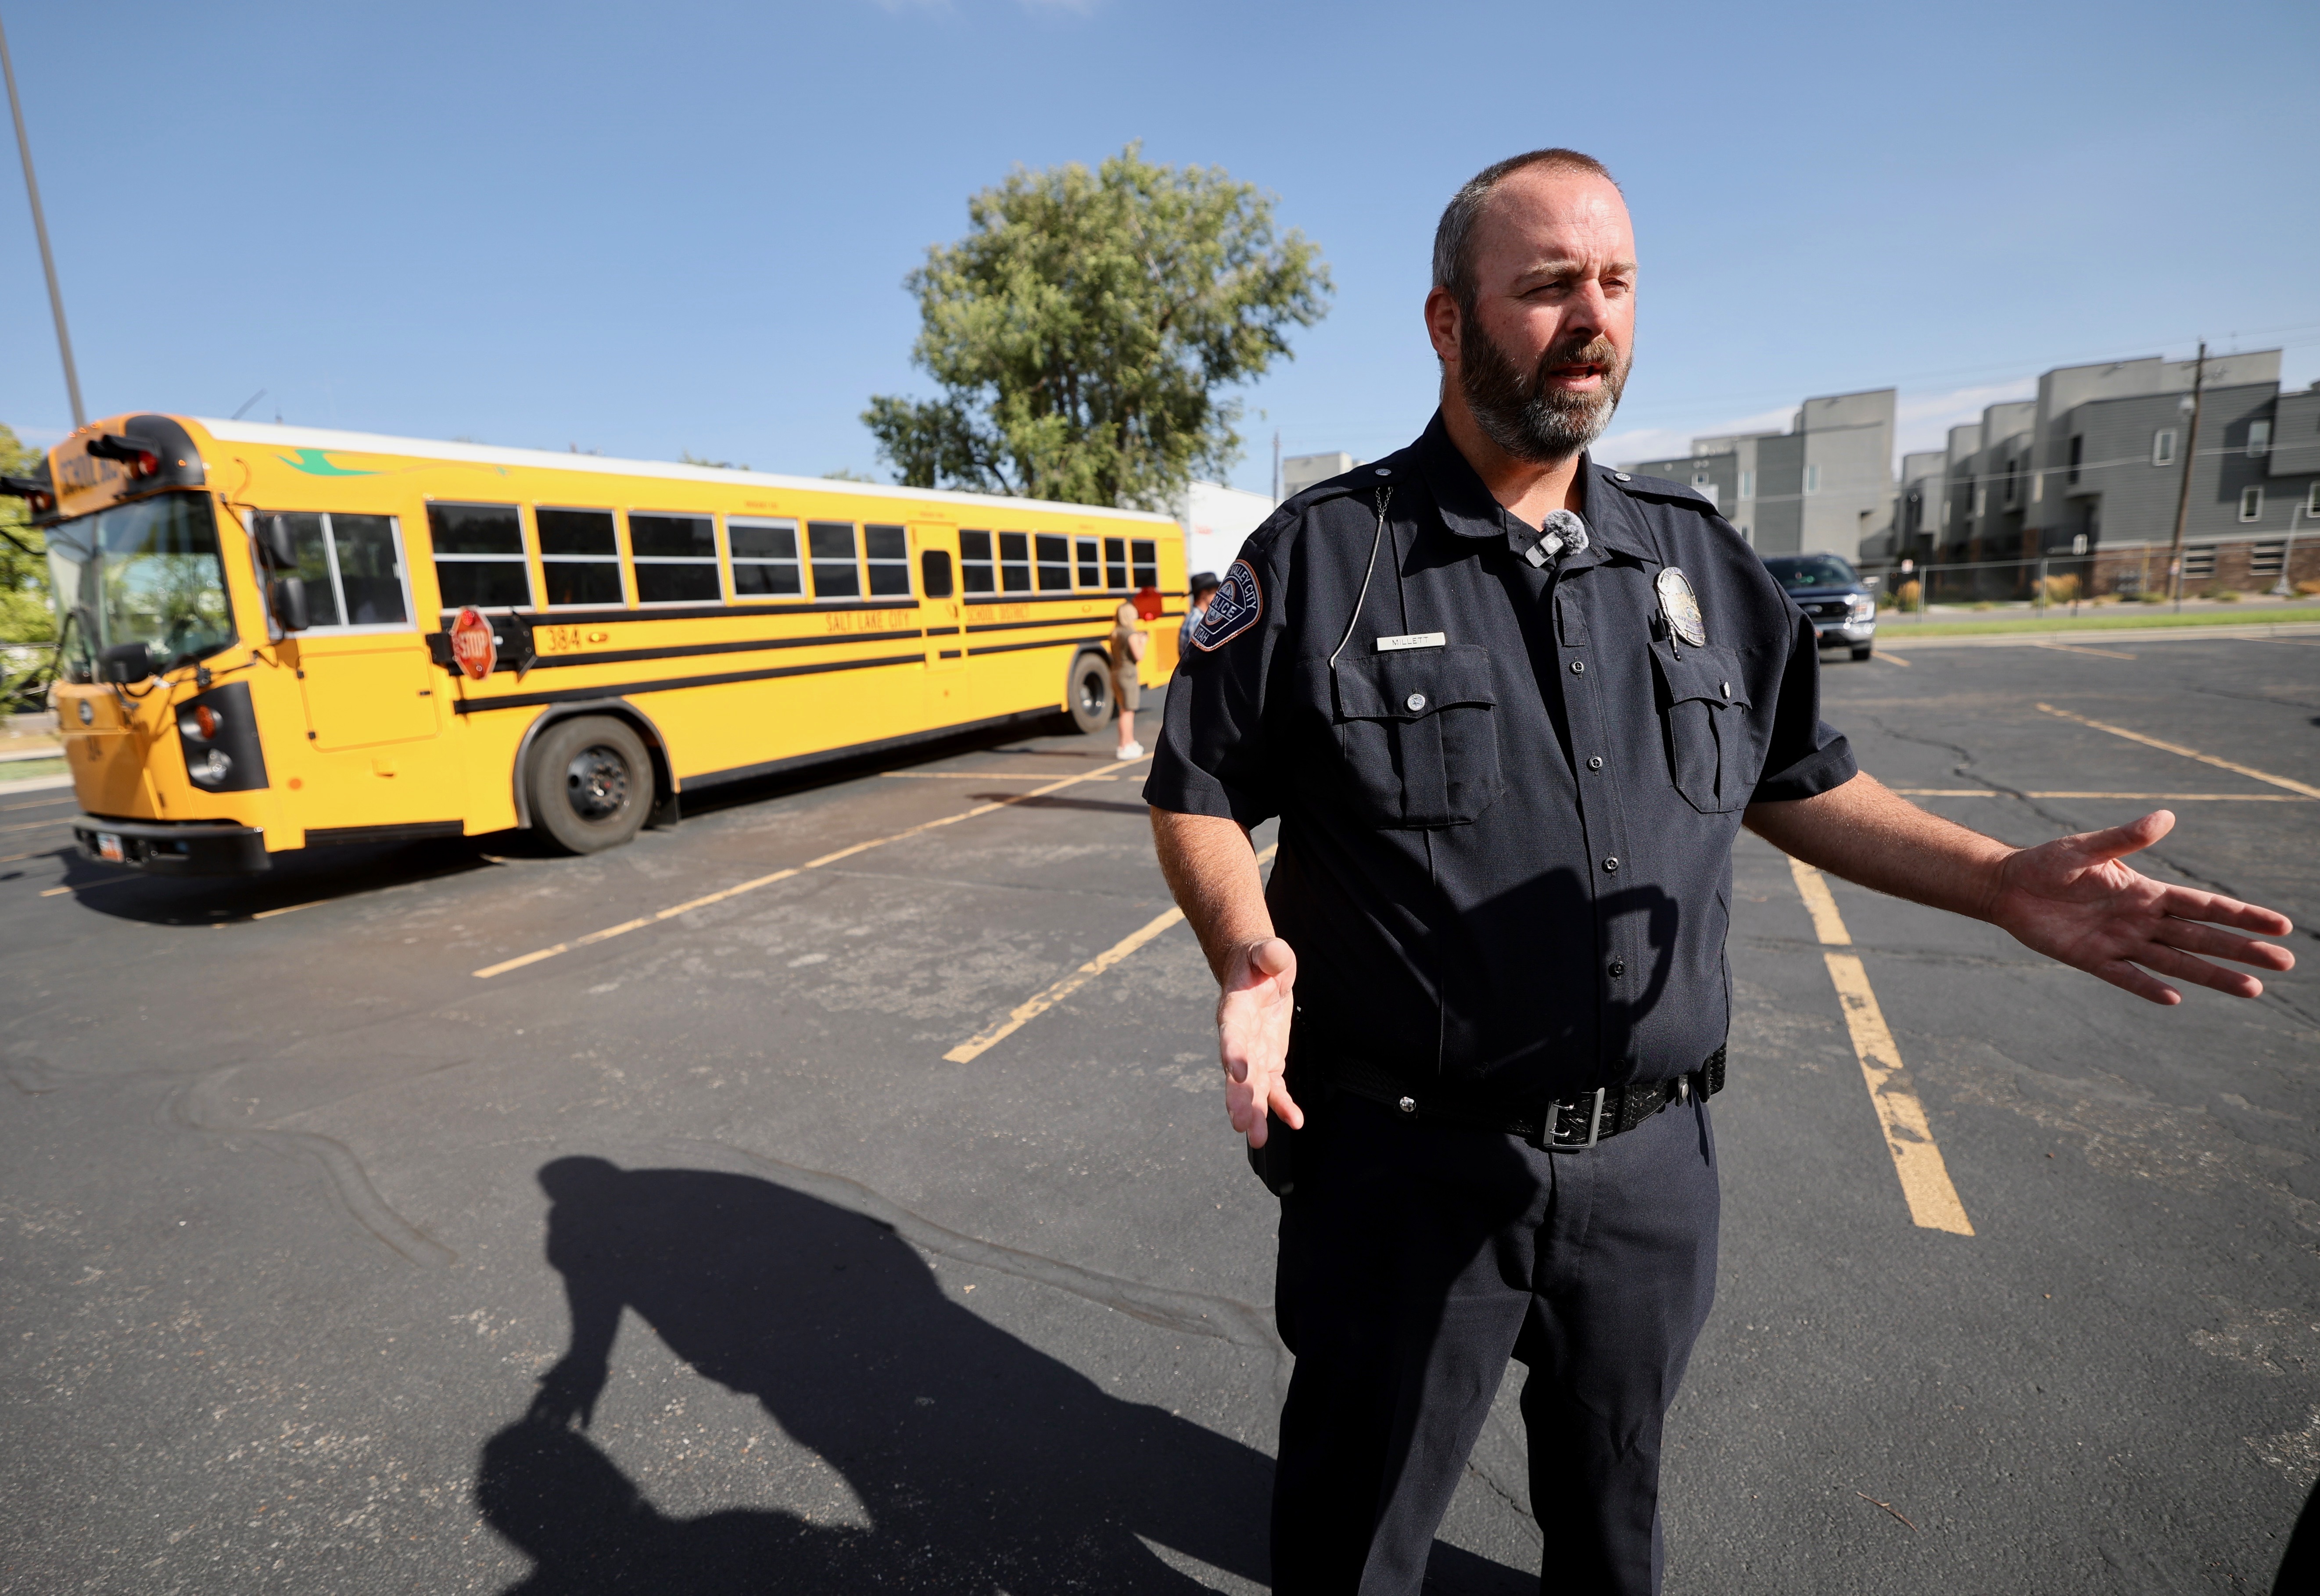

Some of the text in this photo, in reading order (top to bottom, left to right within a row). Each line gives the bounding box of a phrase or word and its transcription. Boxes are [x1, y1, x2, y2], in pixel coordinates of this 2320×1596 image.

[1230, 565, 1256, 609] VALLEY CITY
[966, 605, 993, 622] SCHOOL
[1212, 595, 1237, 618] OLICE
[826, 609, 909, 632] SALT LAKE CITY
[459, 630, 488, 658] STOP
[548, 626, 581, 651] 384
[1194, 627, 1210, 644] UTAH
[1392, 637, 1428, 646] MILLETT
